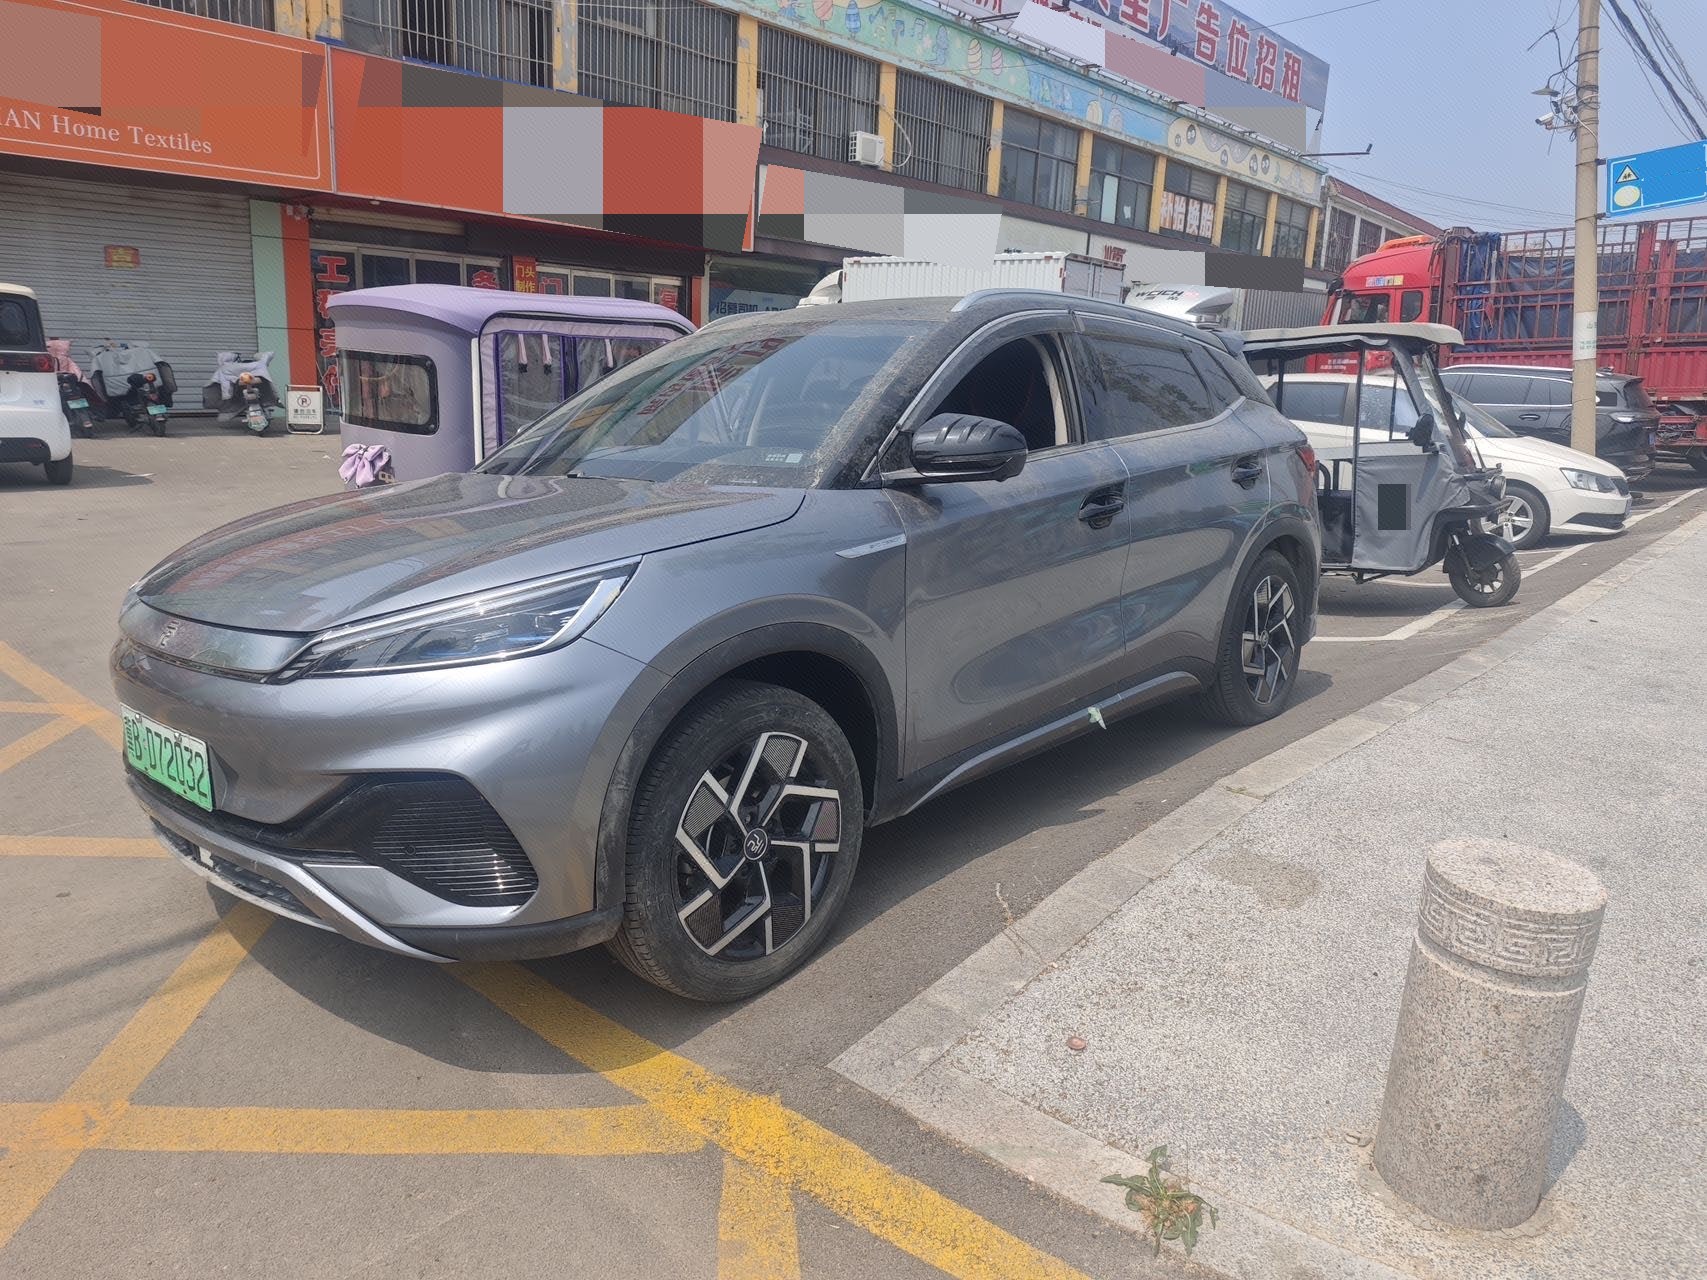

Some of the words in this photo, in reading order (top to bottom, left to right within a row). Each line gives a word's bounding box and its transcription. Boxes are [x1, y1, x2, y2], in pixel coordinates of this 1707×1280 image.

[53, 114, 120, 142] Home
[128, 125, 213, 154] Textiles
[1160, 191, 1214, 238] 补胎换胎
[515, 265, 535, 278] 门头
[515, 279, 536, 293] 制作
